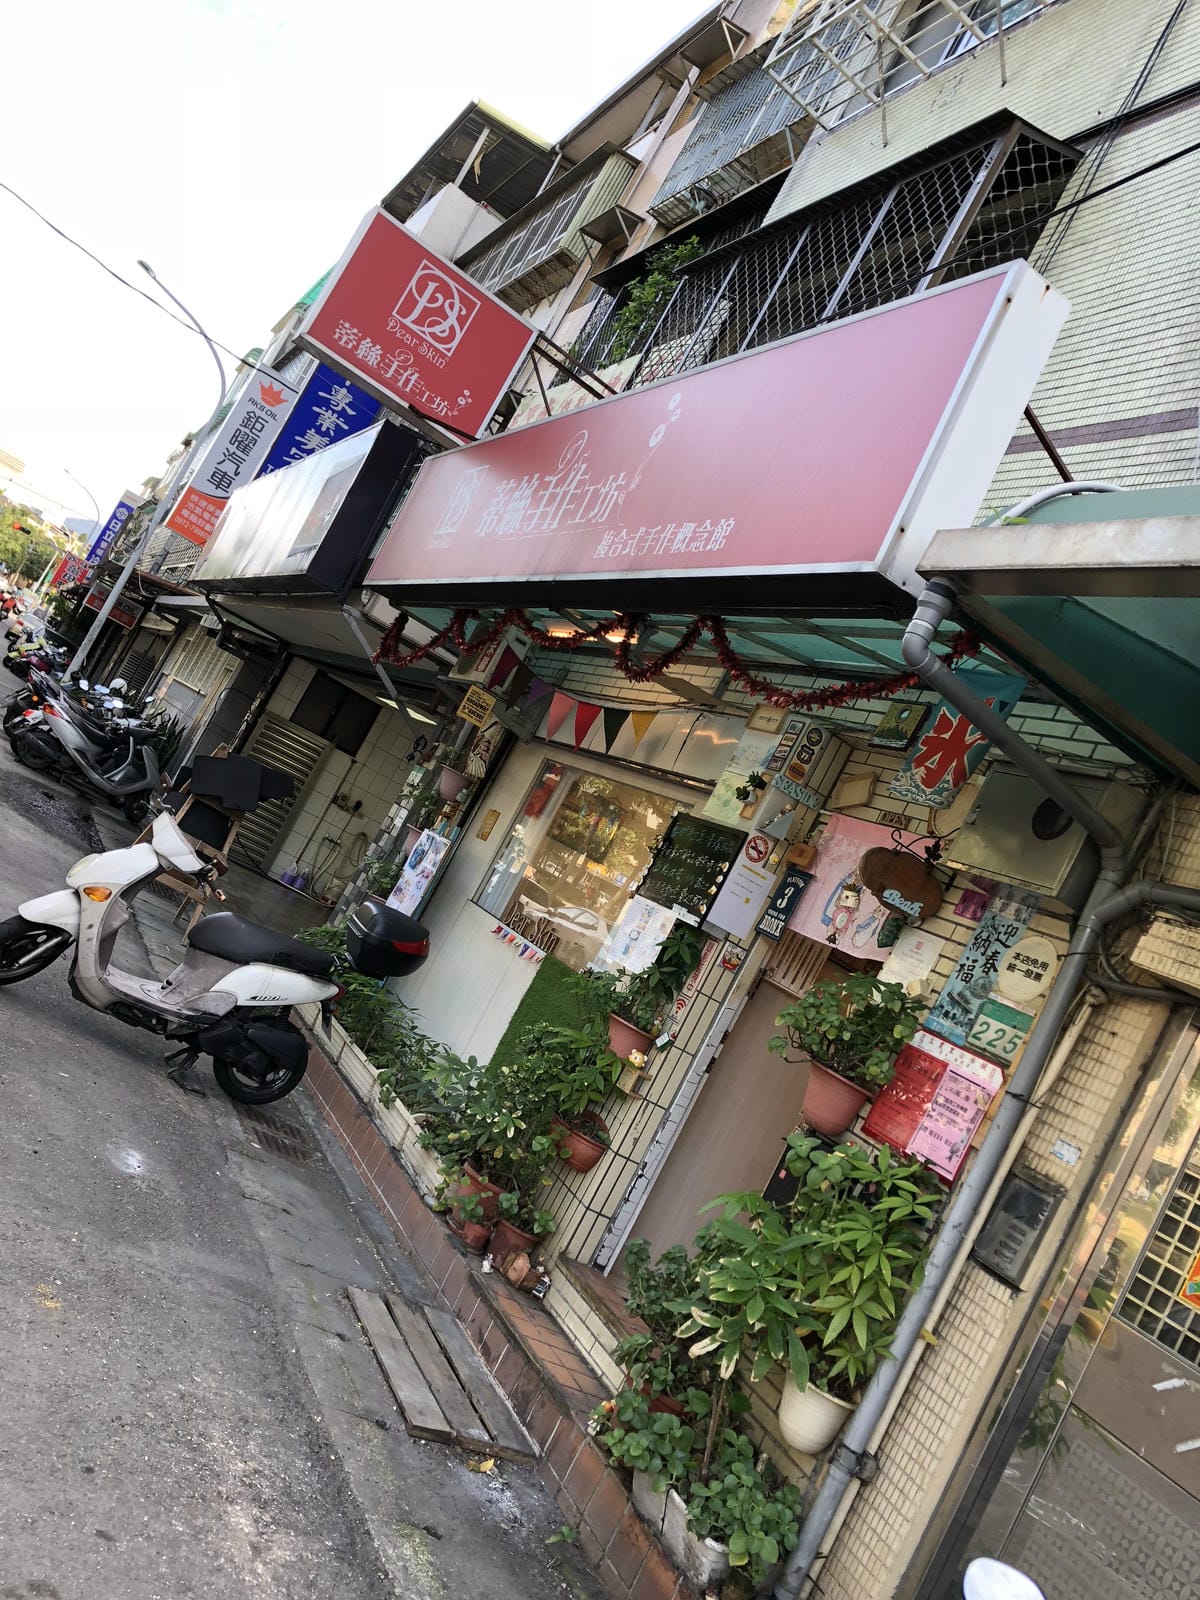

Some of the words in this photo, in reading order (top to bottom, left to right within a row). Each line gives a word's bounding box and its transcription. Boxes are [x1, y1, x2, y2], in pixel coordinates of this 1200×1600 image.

[386, 316, 420, 348] Dear
[418, 341, 447, 369] Skin
[265, 409, 278, 422] OIL
[207, 411, 269, 493] 鉅曜汽車
[777, 886, 794, 908] 3
[882, 889, 924, 917] Beach
[502, 901, 531, 934] Dear
[528, 916, 558, 953] Skin
[760, 915, 785, 936] BRONX
[1012, 951, 1050, 972] 本店免用
[970, 1020, 1025, 1055] 225
